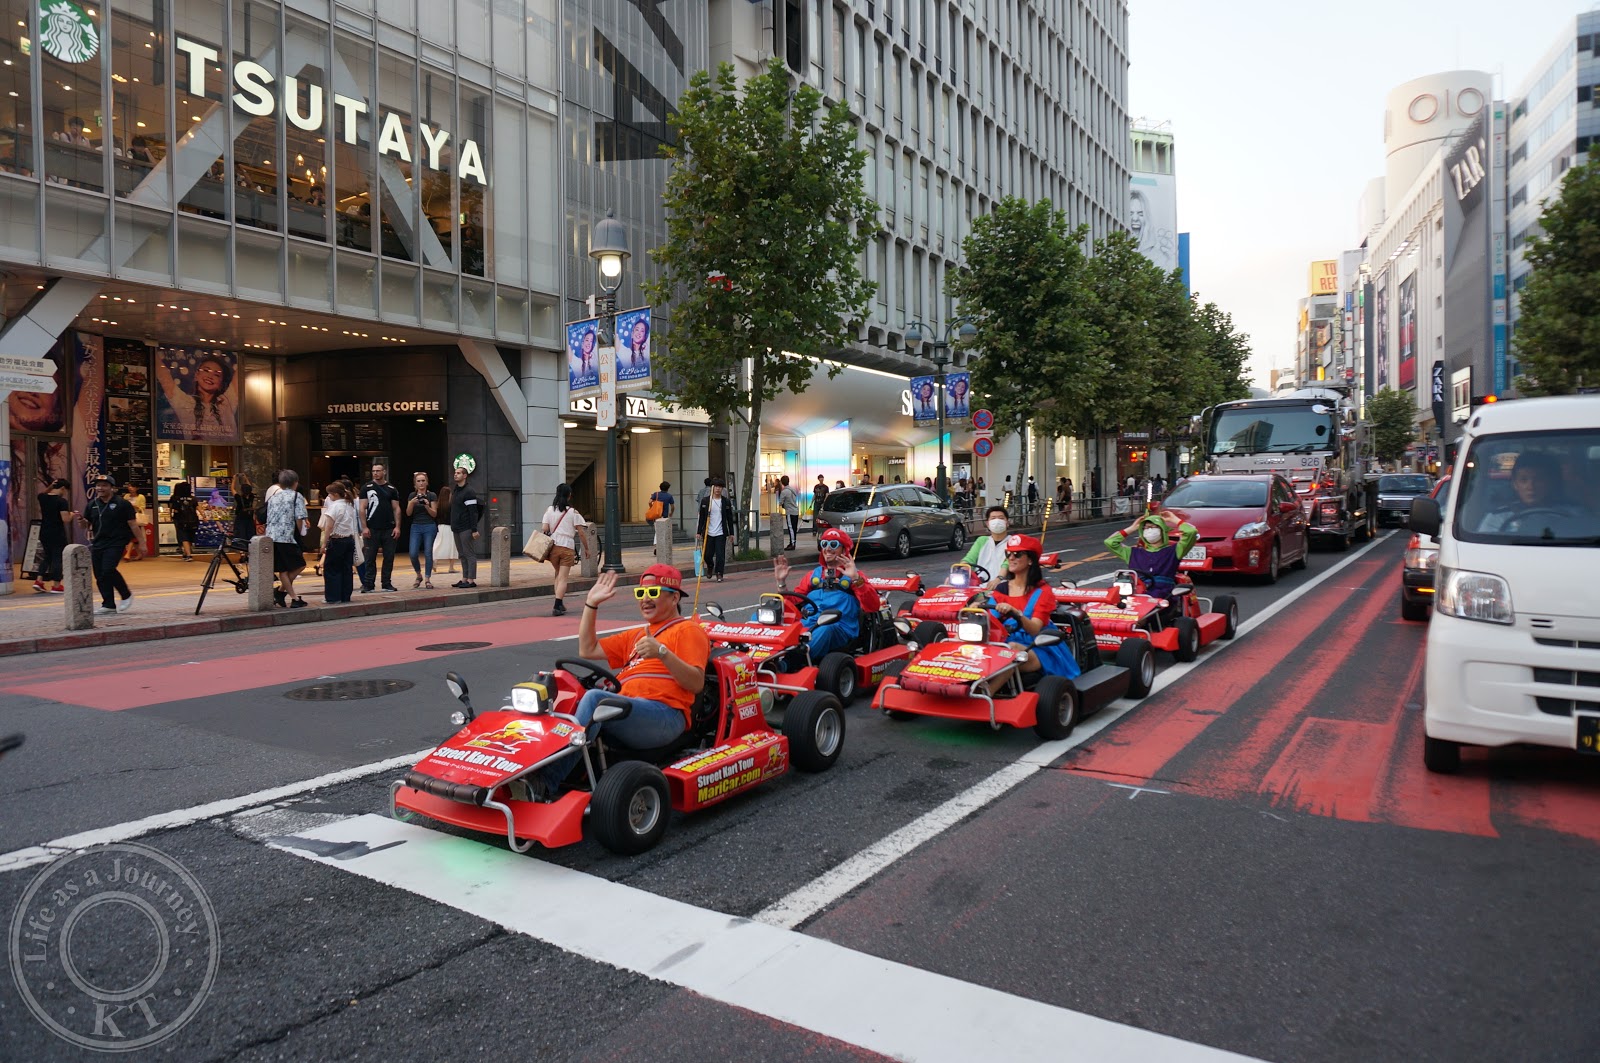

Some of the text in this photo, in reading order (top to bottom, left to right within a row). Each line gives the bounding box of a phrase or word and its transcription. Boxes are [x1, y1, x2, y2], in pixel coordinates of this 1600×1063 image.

[176, 36, 488, 186] TSUTAYA
[600, 354, 609, 420] 公園通り
[1434, 367, 1443, 402] ZARA
[327, 401, 440, 414] STARBUCKS COFFEE
[572, 398, 647, 416] TSYA
[1301, 458, 1320, 467] 926
[711, 624, 742, 635] Street
[742, 626, 763, 635] Kart
[761, 628, 785, 636] Tour
[907, 664, 982, 681] MariCar.com
[918, 659, 984, 673] Street Kart Tour
[433, 747, 523, 773] Street Kart Tour
[680, 744, 751, 773] MariCar.com
[697, 757, 755, 788] Street Kart Tour
[697, 767, 761, 803] MariCar.com
